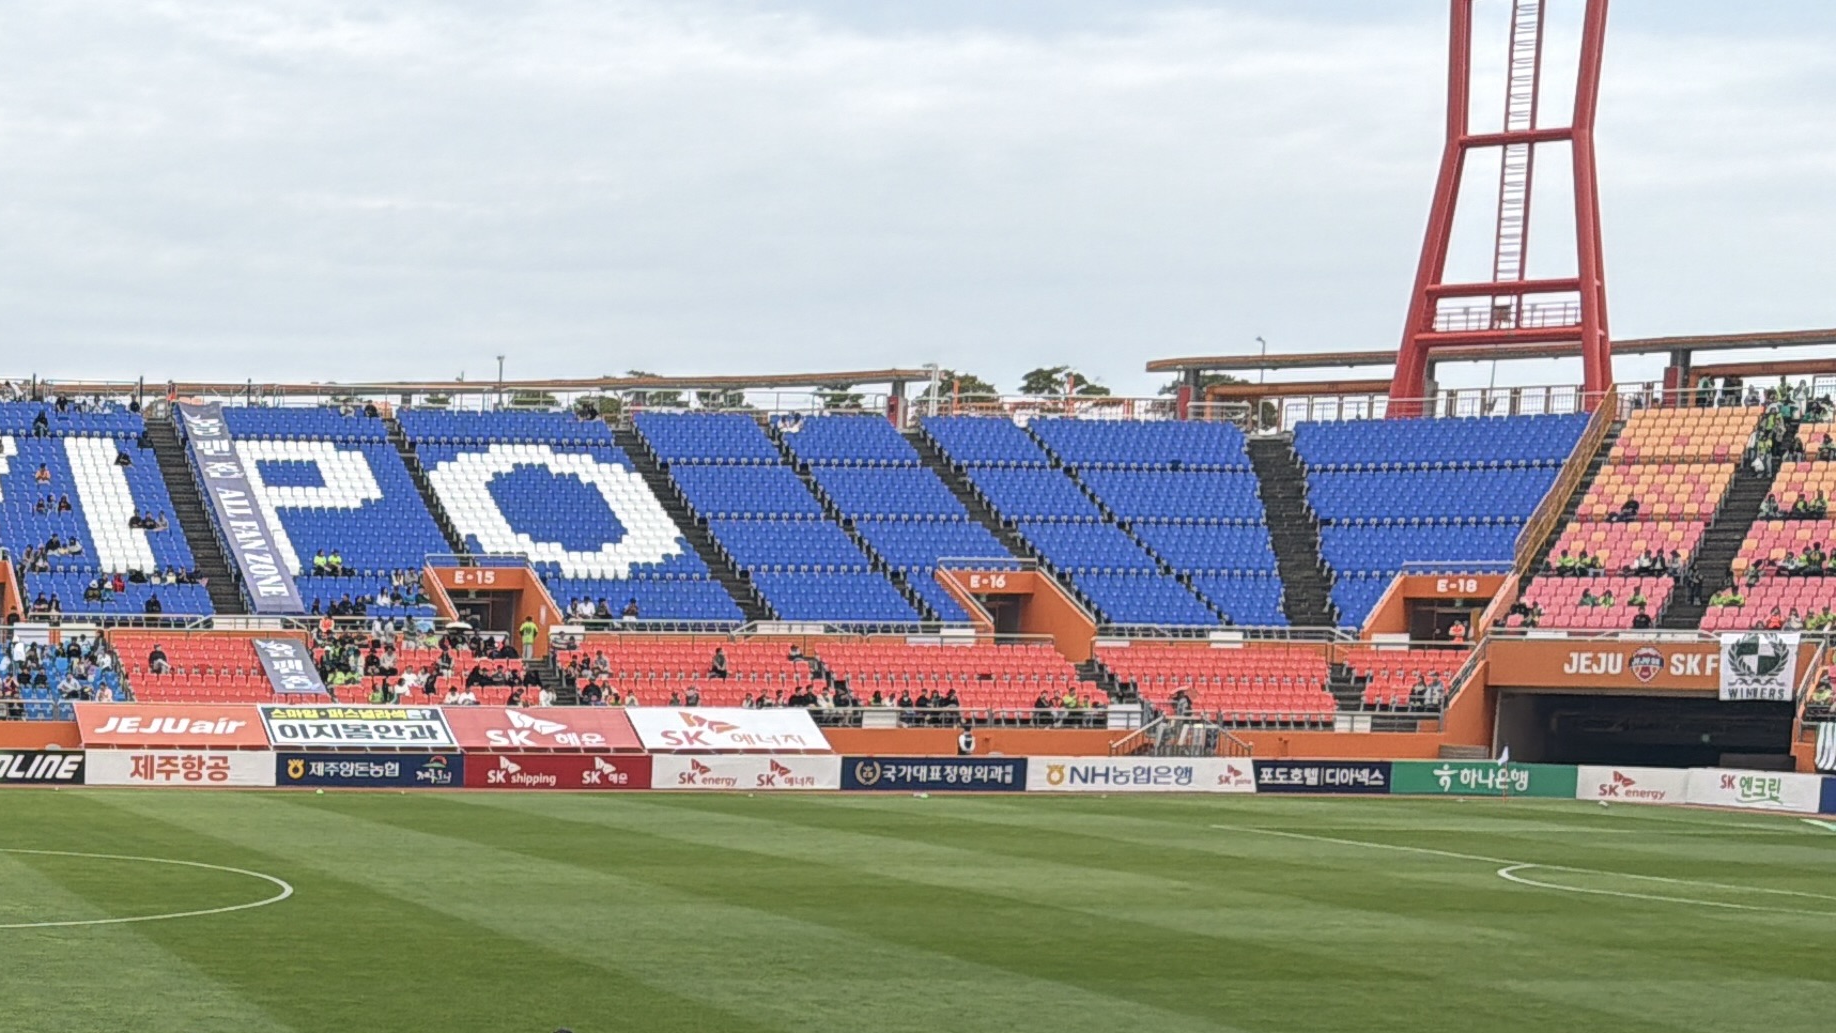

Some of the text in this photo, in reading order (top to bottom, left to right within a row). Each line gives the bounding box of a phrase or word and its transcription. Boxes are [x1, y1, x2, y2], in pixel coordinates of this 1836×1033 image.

[216, 486, 289, 598] ALL FAN ZONE
[454, 570, 495, 585] E-15
[970, 574, 1006, 588] E-16
[1436, 579, 1478, 592] E-18
[1564, 652, 1720, 676] JEJU SK F
[485, 729, 606, 747] SK 해운
[660, 730, 807, 746] SK 에너지
[130, 755, 232, 781] 제주항공
[309, 761, 400, 777] 제주양돈농협
[883, 764, 1004, 783] 국가대표정형외과
[1069, 765, 1193, 785] NH농협은행
[487, 770, 557, 786] SK shipping
[582, 771, 601, 784] SK
[678, 772, 737, 786] SK energy
[757, 774, 814, 786] SK 에너지
[1217, 774, 1231, 785] SK
[1259, 767, 1319, 786] 포도호텔
[1325, 767, 1385, 786] 디아넥스
[1460, 768, 1529, 790] 하나은행
[1598, 784, 1666, 799] SK energy
[1720, 774, 1782, 800] SK 엔크린
